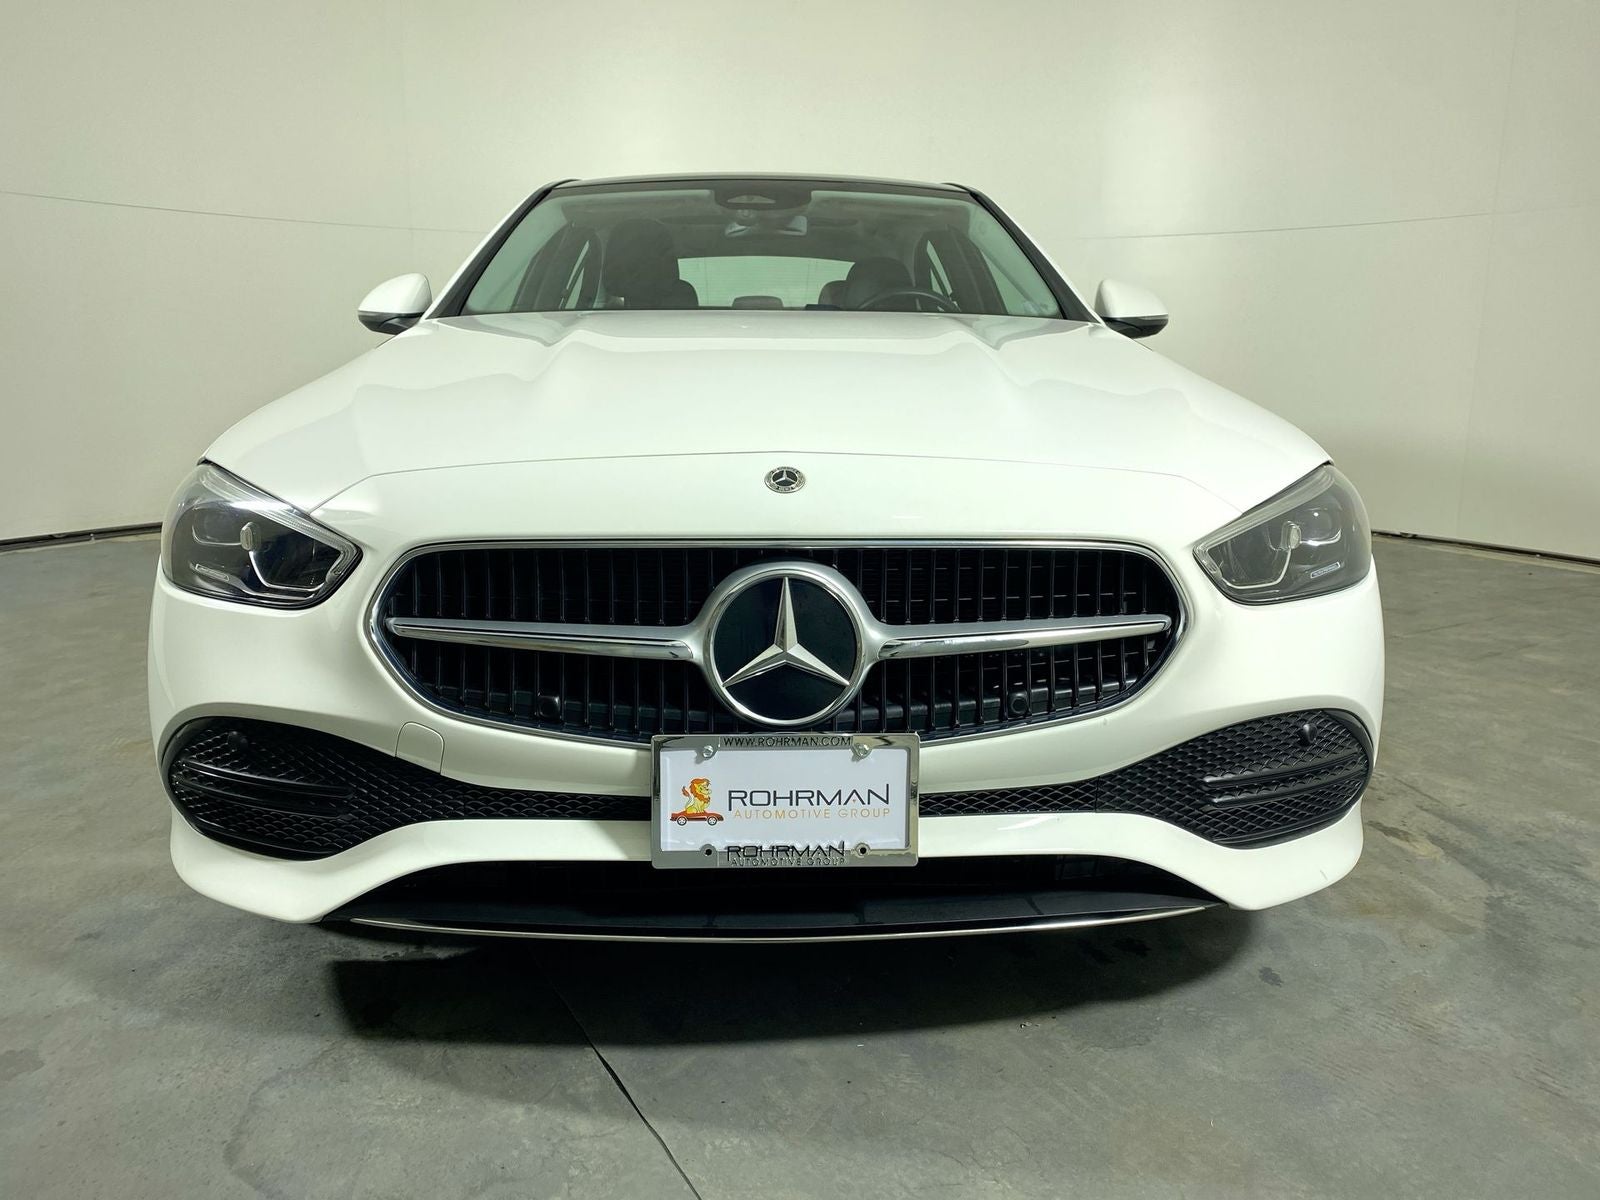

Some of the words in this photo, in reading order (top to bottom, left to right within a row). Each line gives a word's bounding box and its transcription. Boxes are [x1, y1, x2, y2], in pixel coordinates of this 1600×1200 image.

[723, 736, 852, 747] WWW.ROHRMAN.COM
[728, 783, 889, 811] ROHRMAN
[733, 808, 831, 819] AUTOMOTIVE
[838, 807, 890, 818] GROUP
[727, 841, 845, 861] ROHRMAN
[731, 857, 802, 867] AUTOMOTIVE
[808, 856, 845, 866] GROUP
